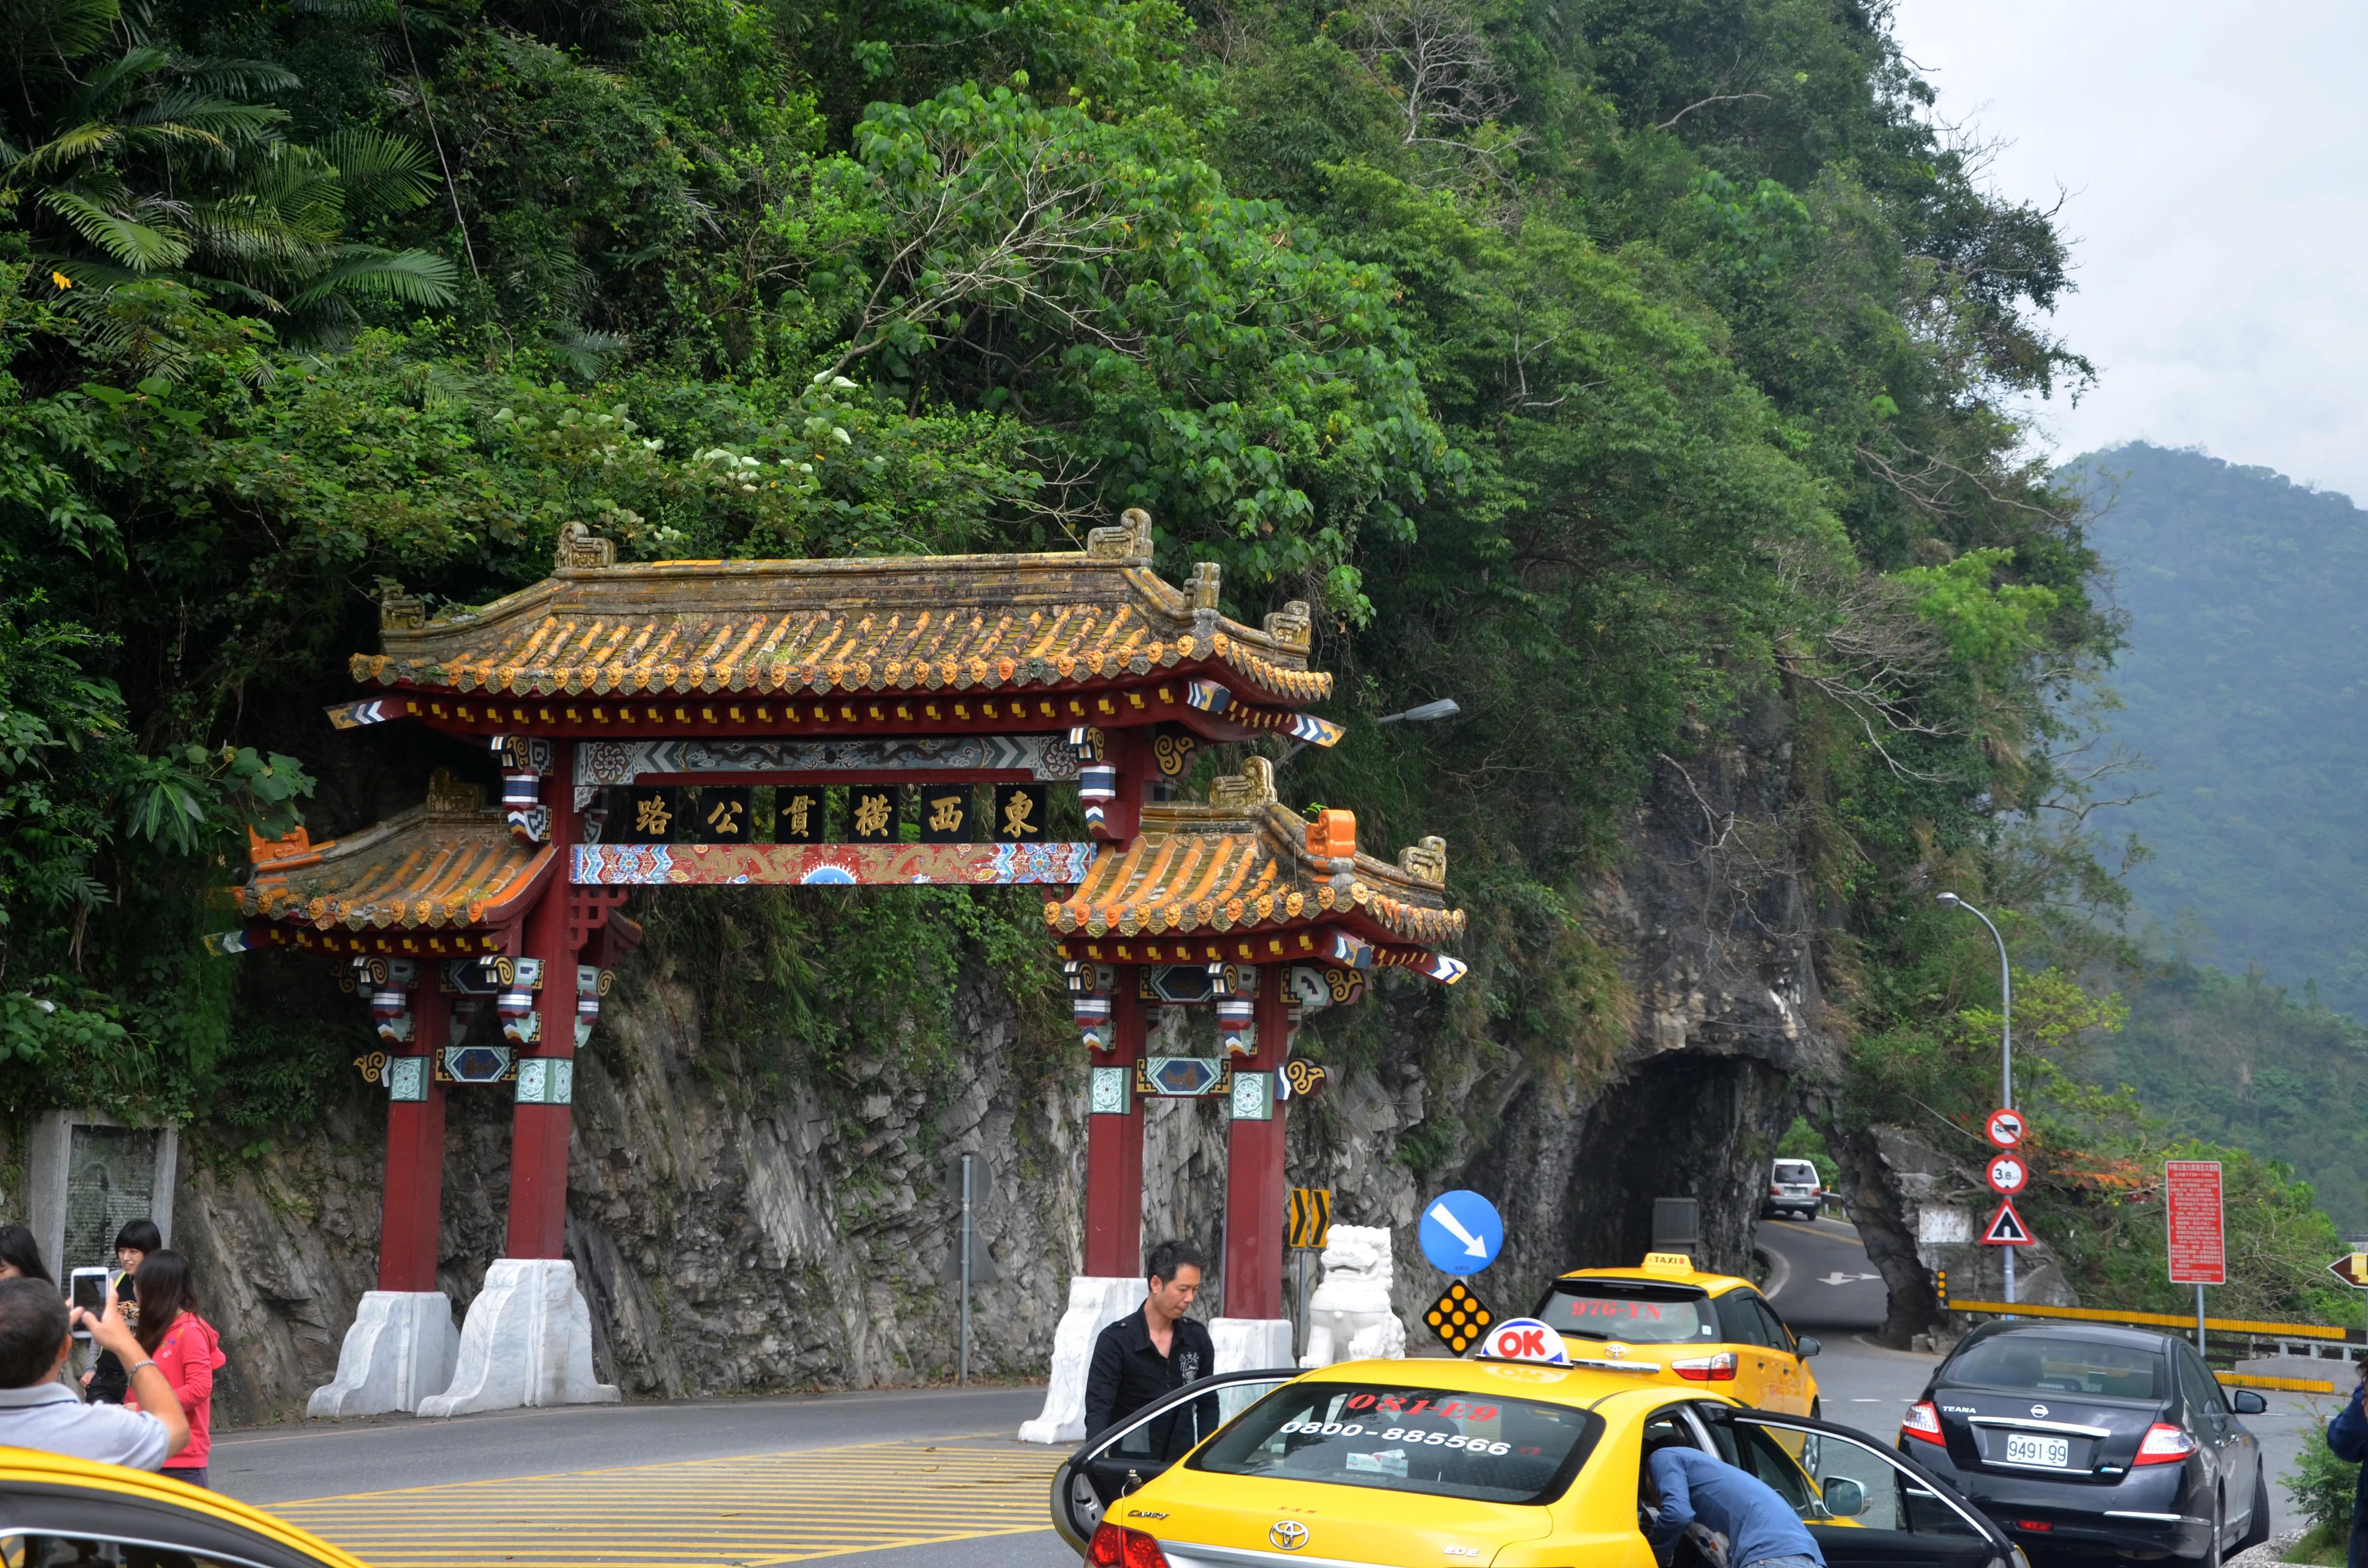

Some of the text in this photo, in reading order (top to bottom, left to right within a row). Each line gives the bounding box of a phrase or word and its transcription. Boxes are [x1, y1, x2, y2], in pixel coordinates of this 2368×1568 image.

[1571, 1300, 1664, 1320] 976-YN
[1498, 1330, 1546, 1359] OK
[1348, 1394, 1498, 1421] 081-E9
[1280, 1421, 1512, 1456] 0800-885566
[1128, 1510, 1170, 1520] CAMRY
